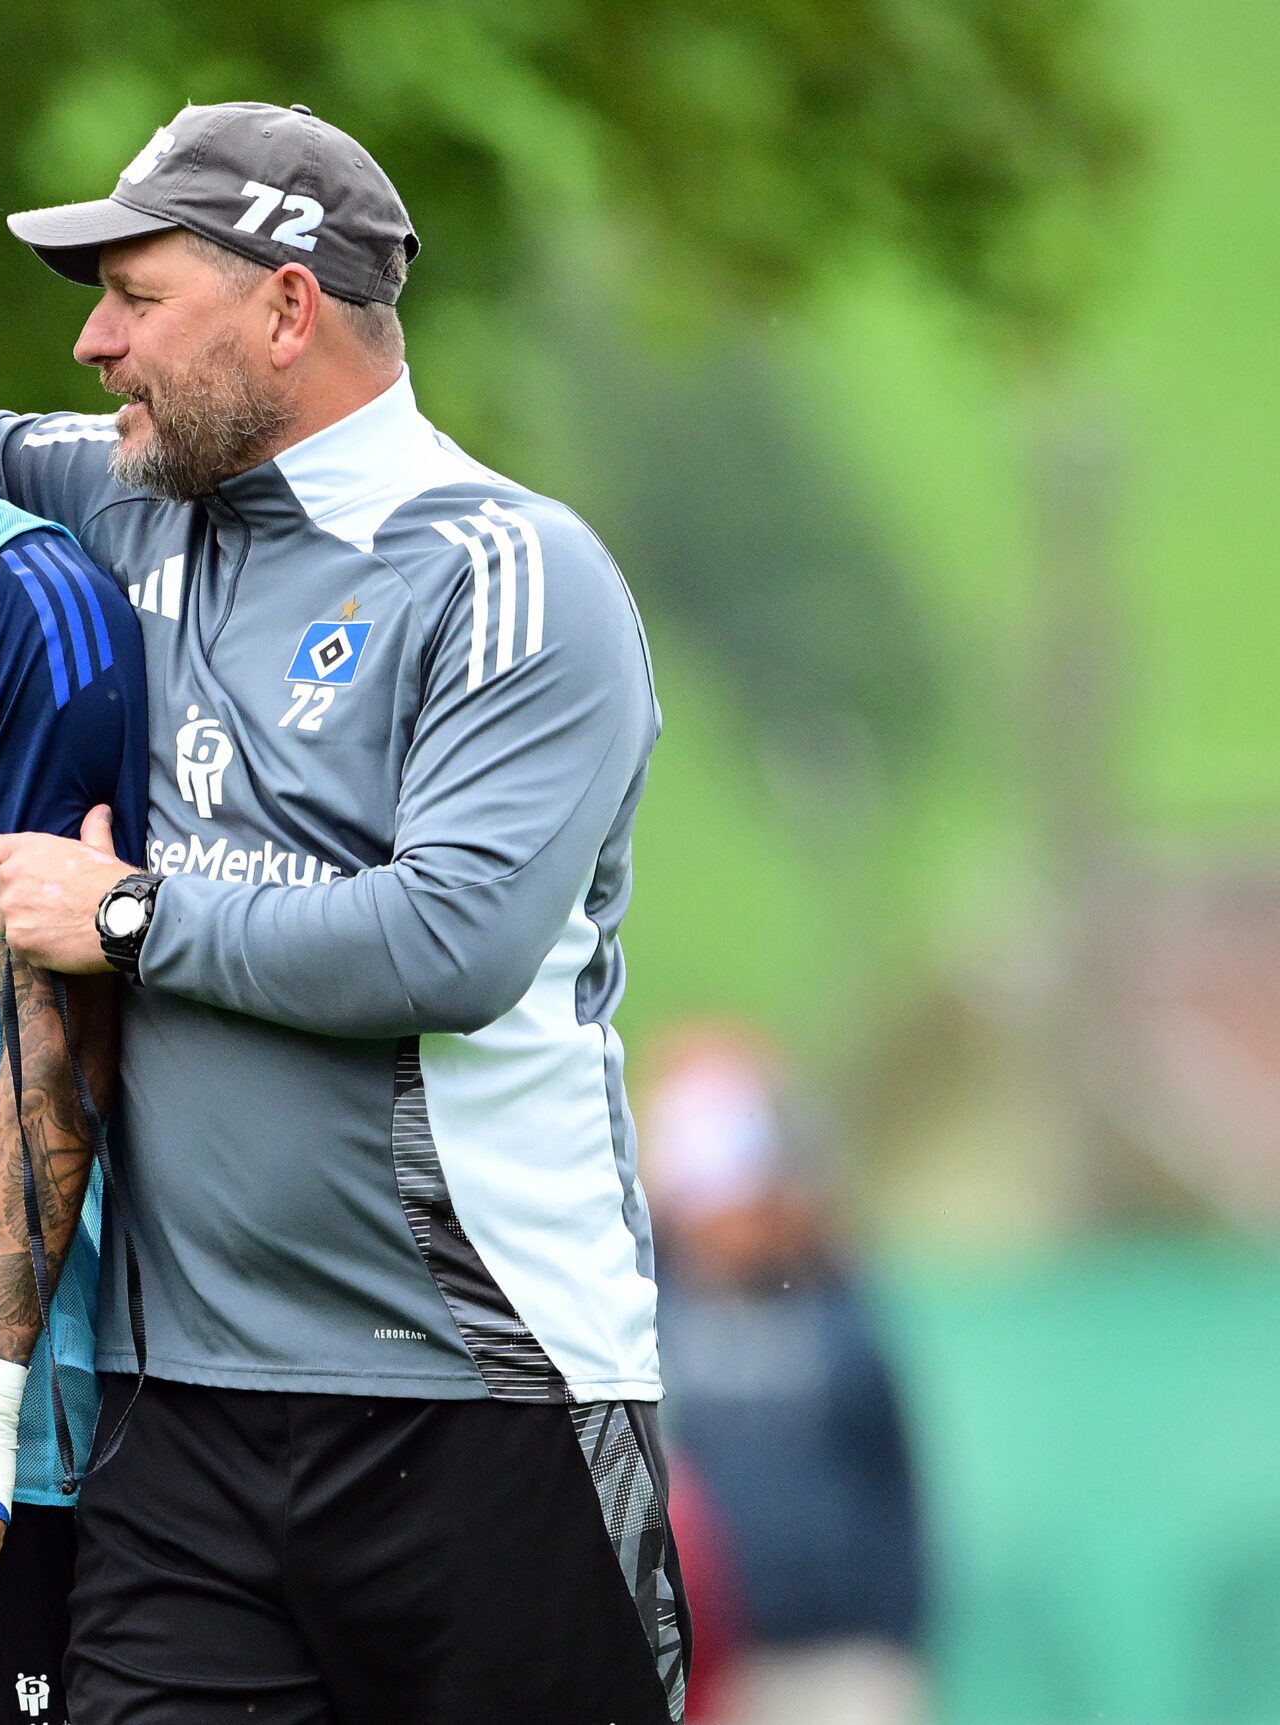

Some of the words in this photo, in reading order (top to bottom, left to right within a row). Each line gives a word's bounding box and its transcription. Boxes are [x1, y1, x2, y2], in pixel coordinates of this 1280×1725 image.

[233, 180, 325, 252] 72
[277, 683, 335, 732] 72
[373, 1328, 427, 1341] AEROREADY
